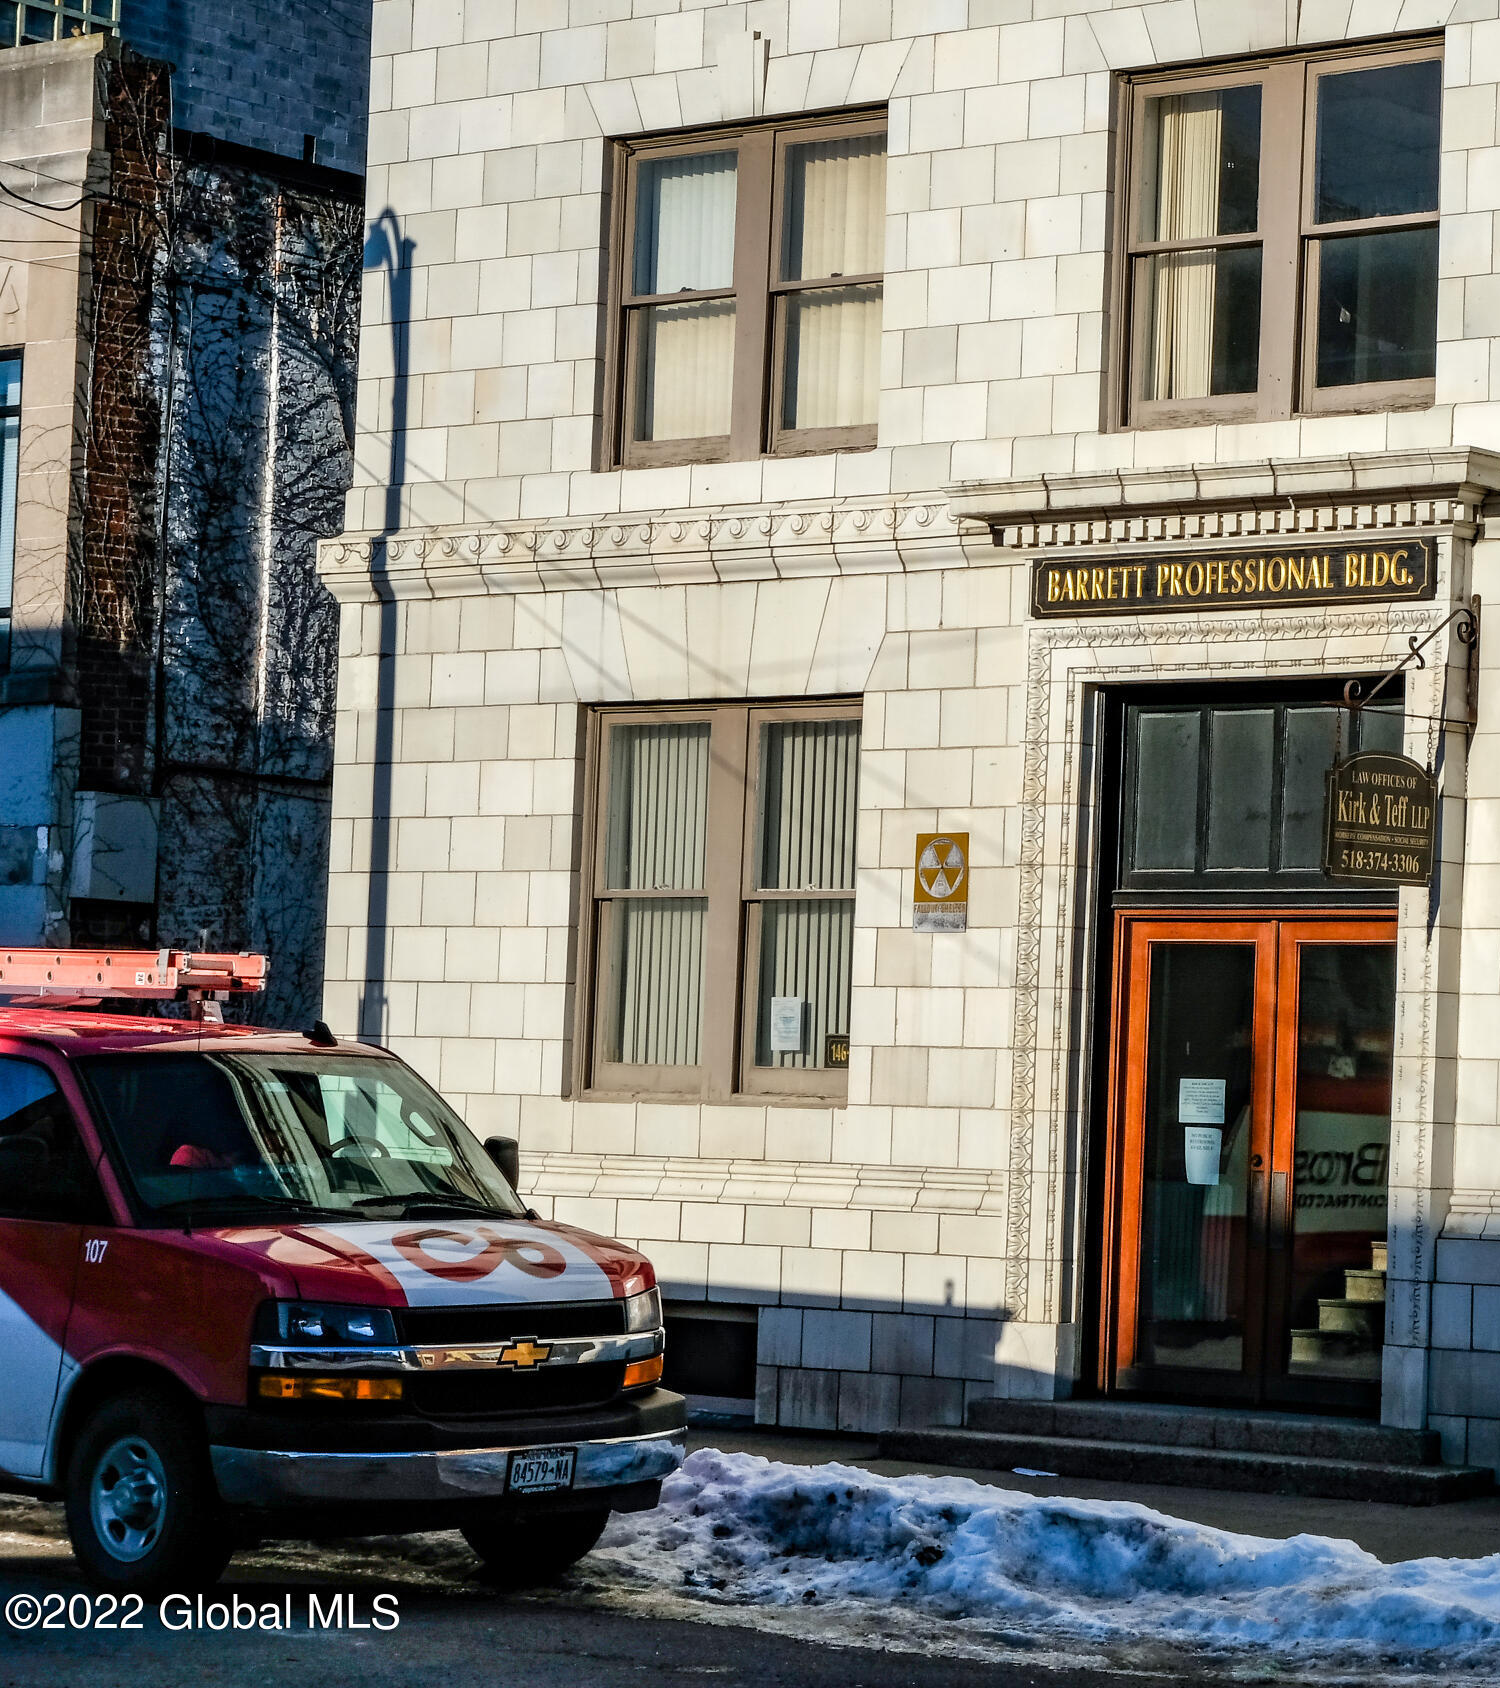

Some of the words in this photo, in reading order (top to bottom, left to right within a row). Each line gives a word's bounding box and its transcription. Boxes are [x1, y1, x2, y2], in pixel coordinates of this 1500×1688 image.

[1047, 564, 1147, 602] BARRETT
[1155, 555, 1334, 597] PROFESSIONAL
[1344, 549, 1414, 588] BLDG.
[1352, 770, 1370, 783] LAW
[1371, 772, 1405, 788] OFFICES
[1406, 777, 1418, 789] OF
[1337, 790, 1367, 823] Kirk
[1369, 793, 1381, 826] &
[1384, 794, 1409, 828] Teff
[1411, 805, 1430, 830] LLP
[1341, 849, 1420, 874] 518-374-3306
[941, 903, 966, 913] SHELTER
[84, 1238, 109, 1264] 107
